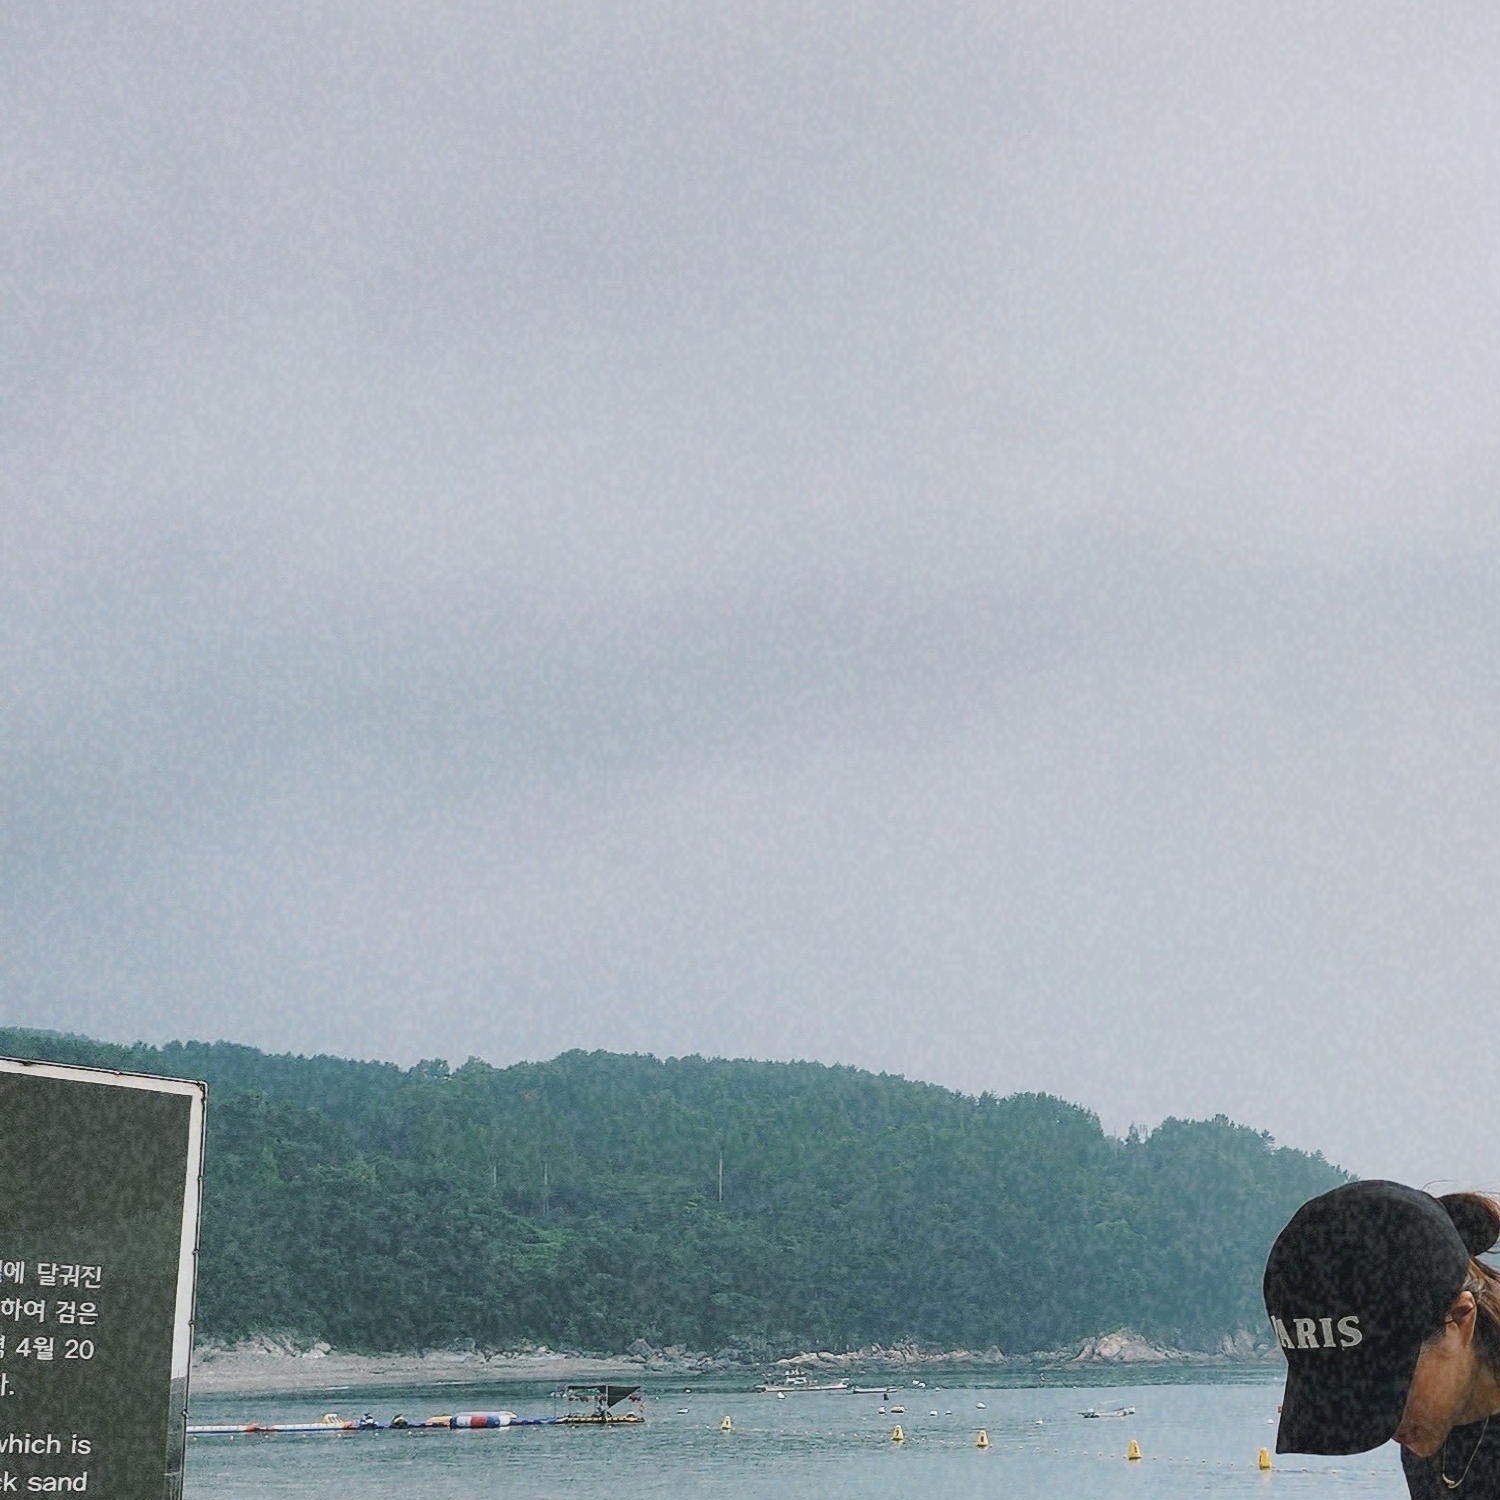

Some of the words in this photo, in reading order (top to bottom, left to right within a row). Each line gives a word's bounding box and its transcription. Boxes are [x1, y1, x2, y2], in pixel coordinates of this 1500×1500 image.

[0, 1260, 25, 1284] 에
[37, 1262, 102, 1289] 달궈진
[55, 1301, 99, 1325] 검은
[1270, 1315, 1363, 1350] ARIS
[15, 1336, 54, 1360] 4월
[64, 1338, 95, 1360] 20
[71, 1433, 92, 1455] is
[0, 1471, 18, 1492] k
[26, 1471, 88, 1492] sand
